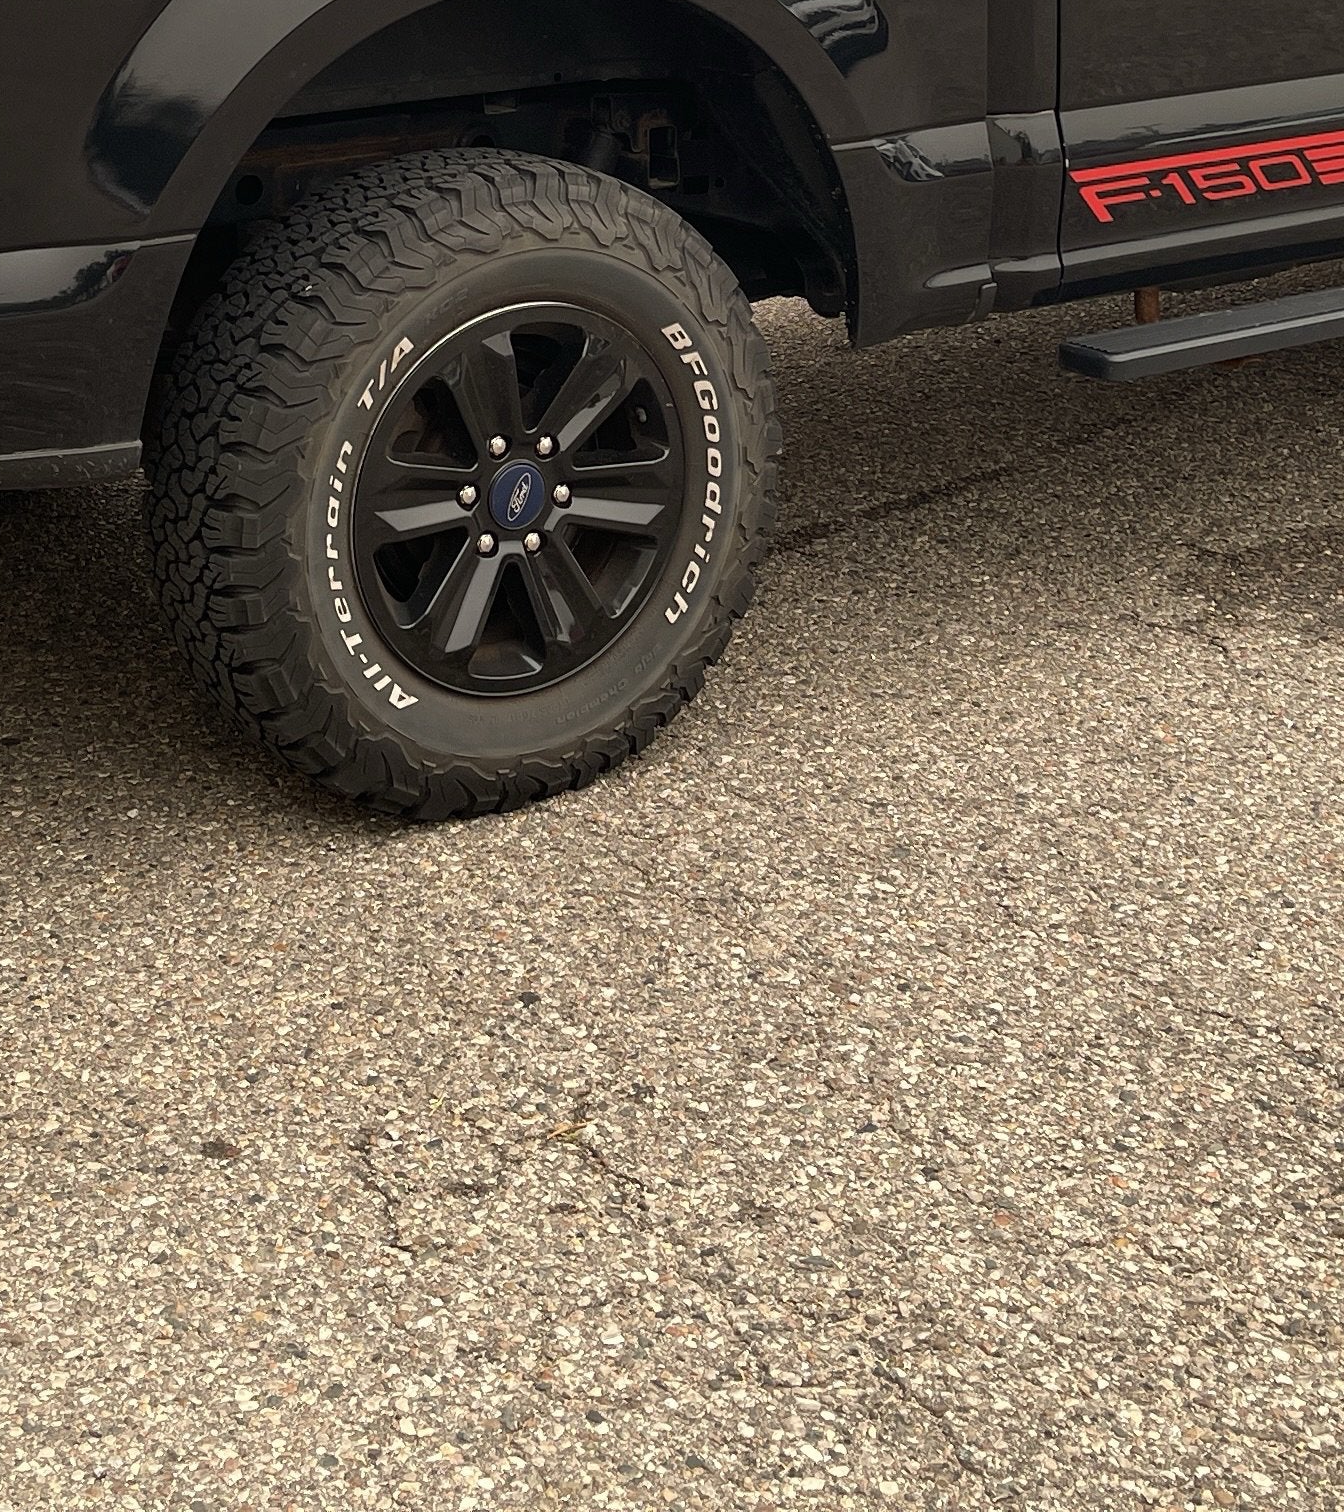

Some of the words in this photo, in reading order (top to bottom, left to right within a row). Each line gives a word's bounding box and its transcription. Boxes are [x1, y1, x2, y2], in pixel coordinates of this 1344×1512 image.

[357, 336, 415, 411] T/A
[660, 322, 723, 625] BFGoodrich
[325, 439, 420, 711] All-Terrain
